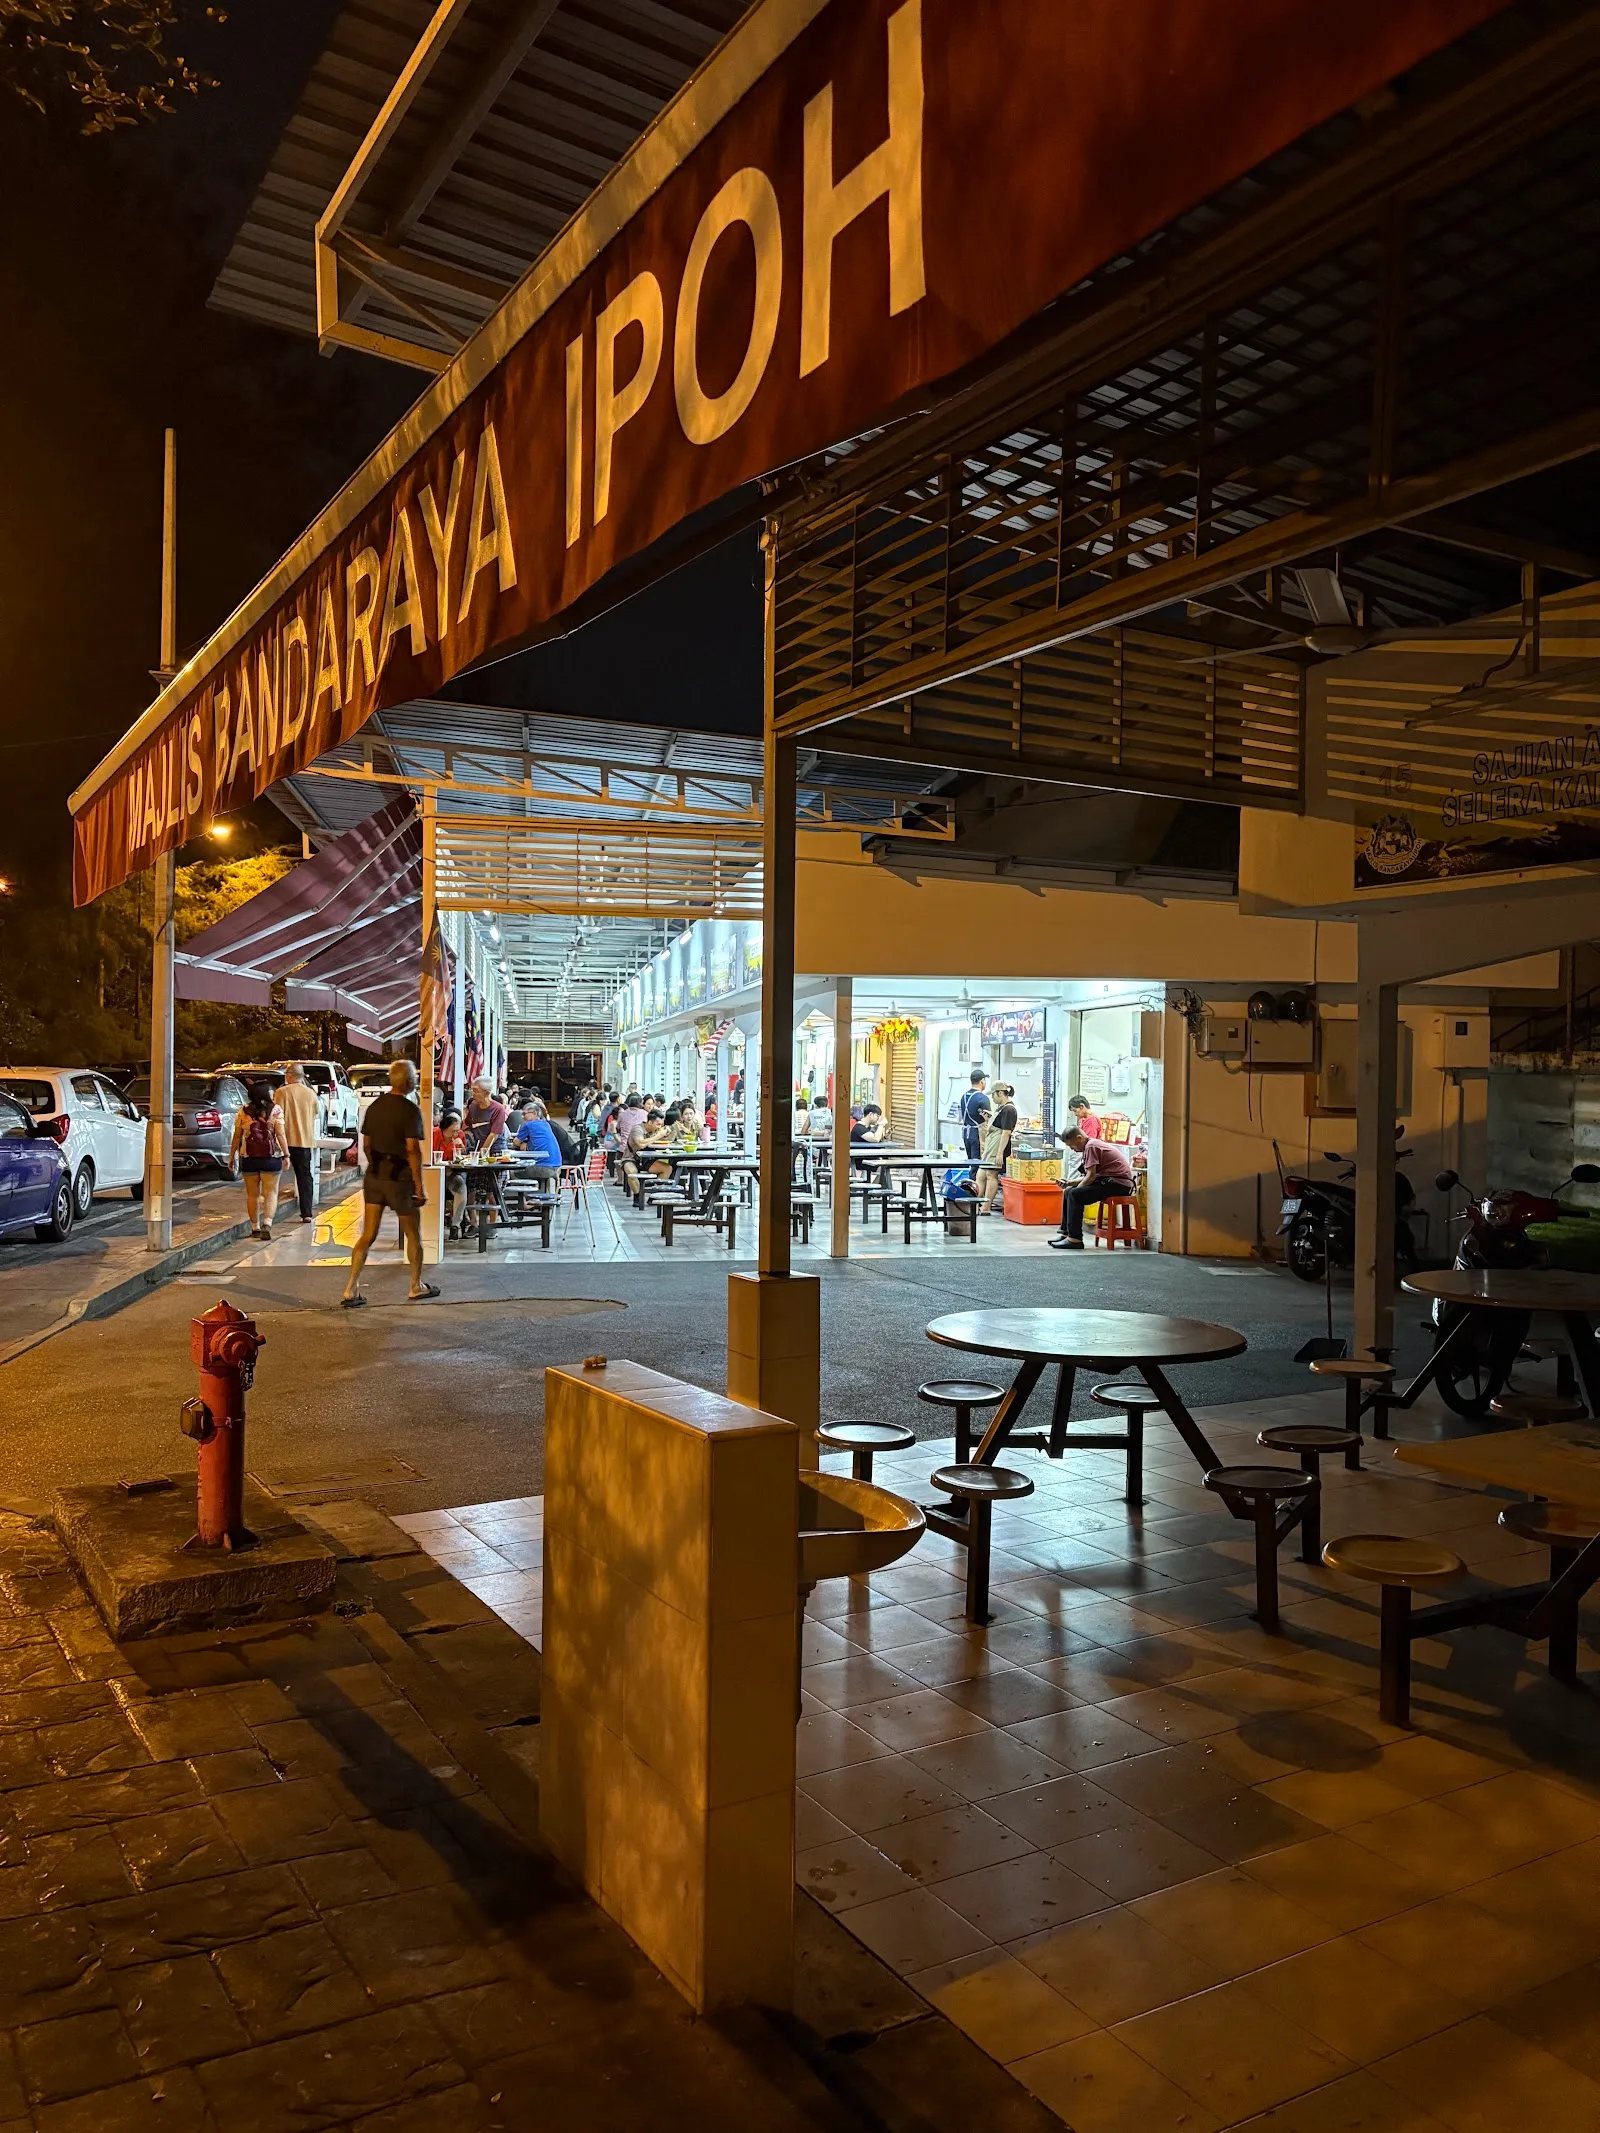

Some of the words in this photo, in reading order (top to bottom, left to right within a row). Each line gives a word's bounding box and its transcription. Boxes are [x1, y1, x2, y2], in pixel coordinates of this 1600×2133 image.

[129, 713, 203, 853] MAJLIS
[213, 422, 517, 791] BANDARAYA
[566, 0, 926, 549] IPOH
[1473, 736, 1574, 785] SAJIAN
[1442, 782, 1545, 827] SELERA
